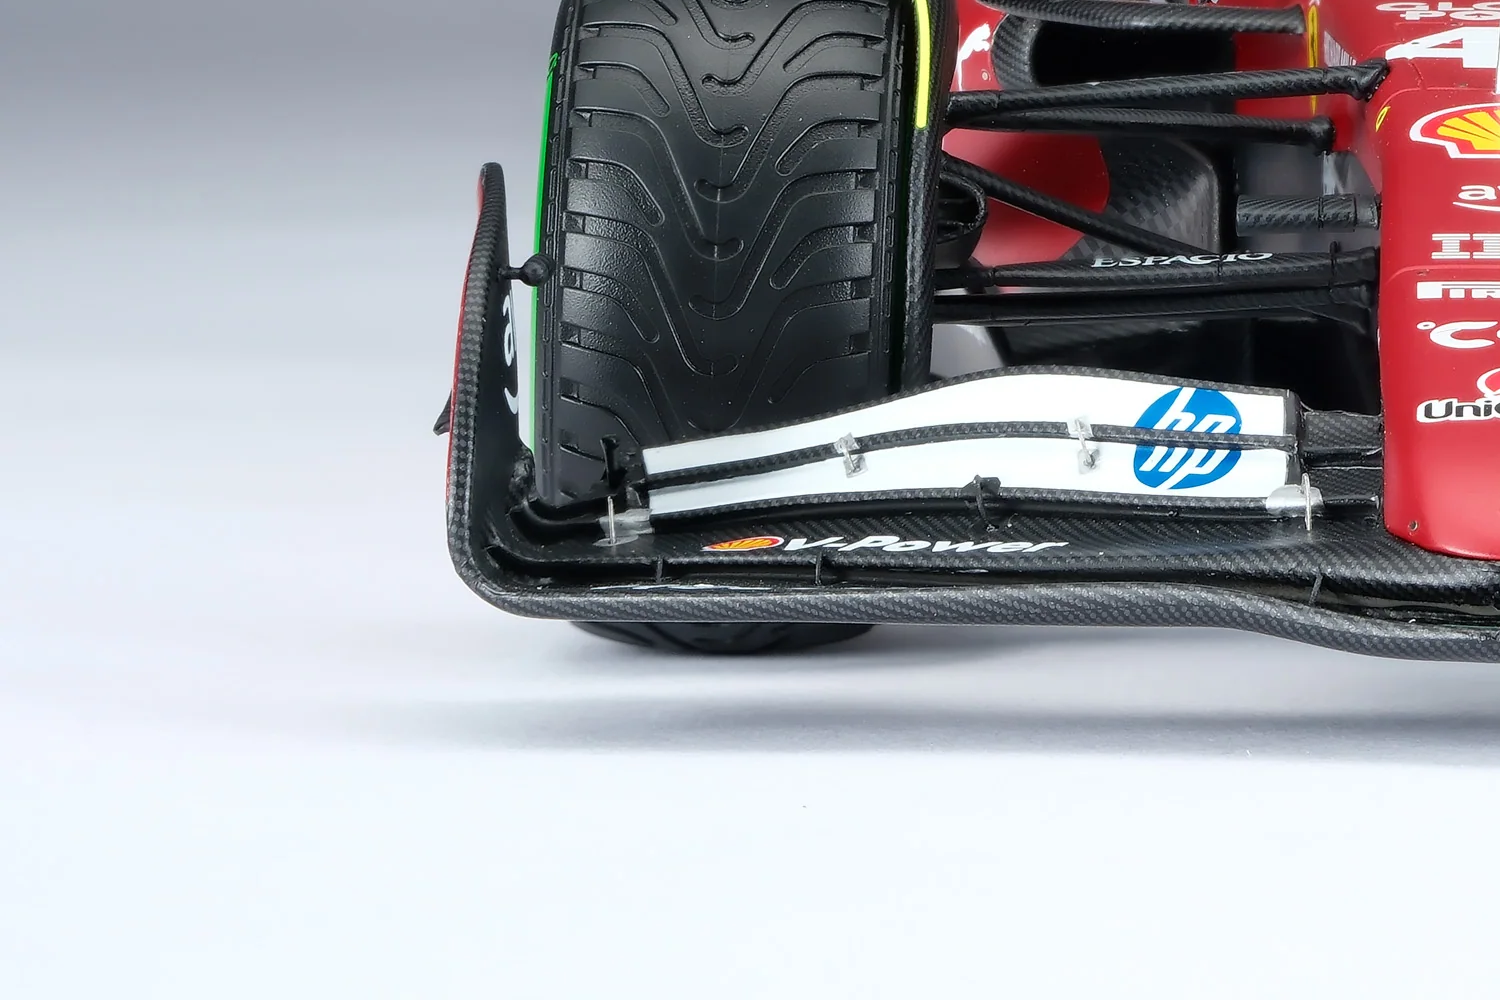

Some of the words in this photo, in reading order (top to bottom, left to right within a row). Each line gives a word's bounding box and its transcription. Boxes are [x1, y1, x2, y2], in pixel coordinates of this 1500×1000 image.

[1091, 253, 1273, 268] ESPACIO
[1139, 387, 1236, 489] hp
[784, 535, 1069, 552] V-Power
